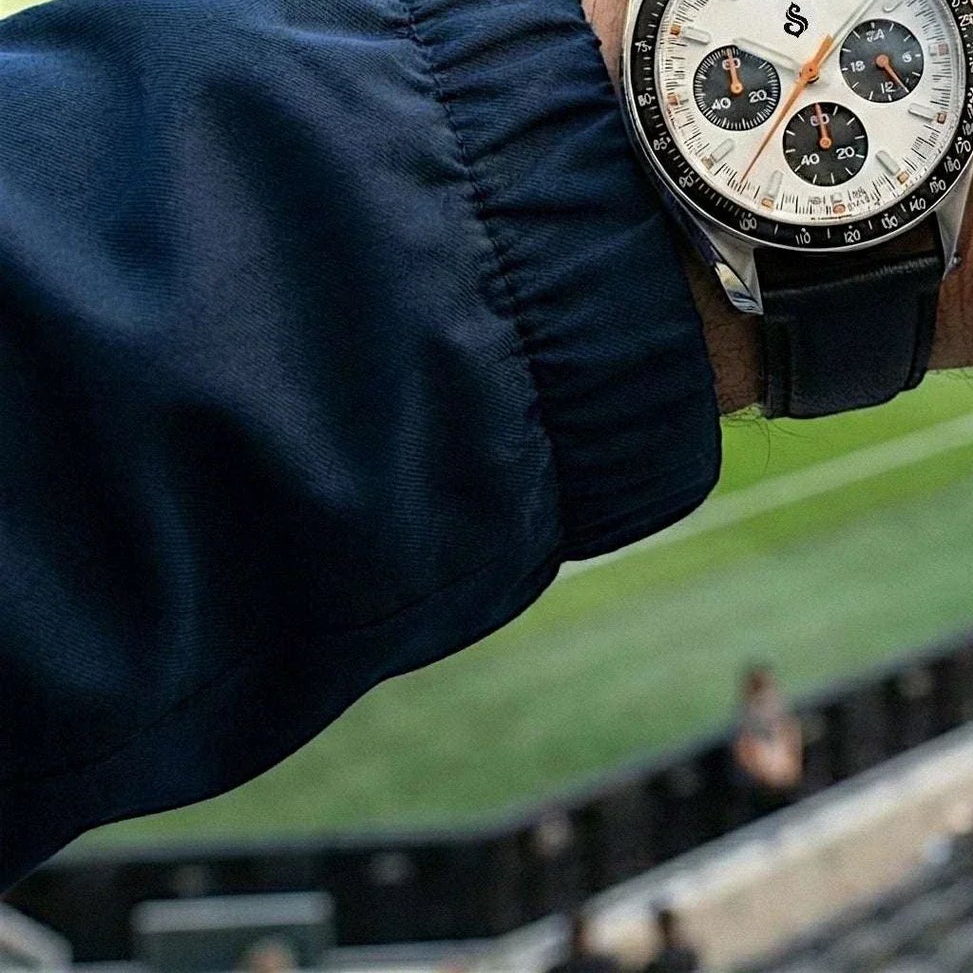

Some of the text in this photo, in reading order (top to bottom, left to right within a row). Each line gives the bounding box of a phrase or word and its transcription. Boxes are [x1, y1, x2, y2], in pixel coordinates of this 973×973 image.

[635, 41, 650, 52] 75
[881, 81, 896, 94] 12
[748, 89, 767, 103] 20
[711, 97, 731, 110] 40
[653, 138, 668, 150] 85
[955, 140, 971, 153] 170
[801, 153, 820, 165] 40
[836, 146, 855, 160] 20
[795, 232, 811, 244] 110
[843, 229, 860, 243] 120
